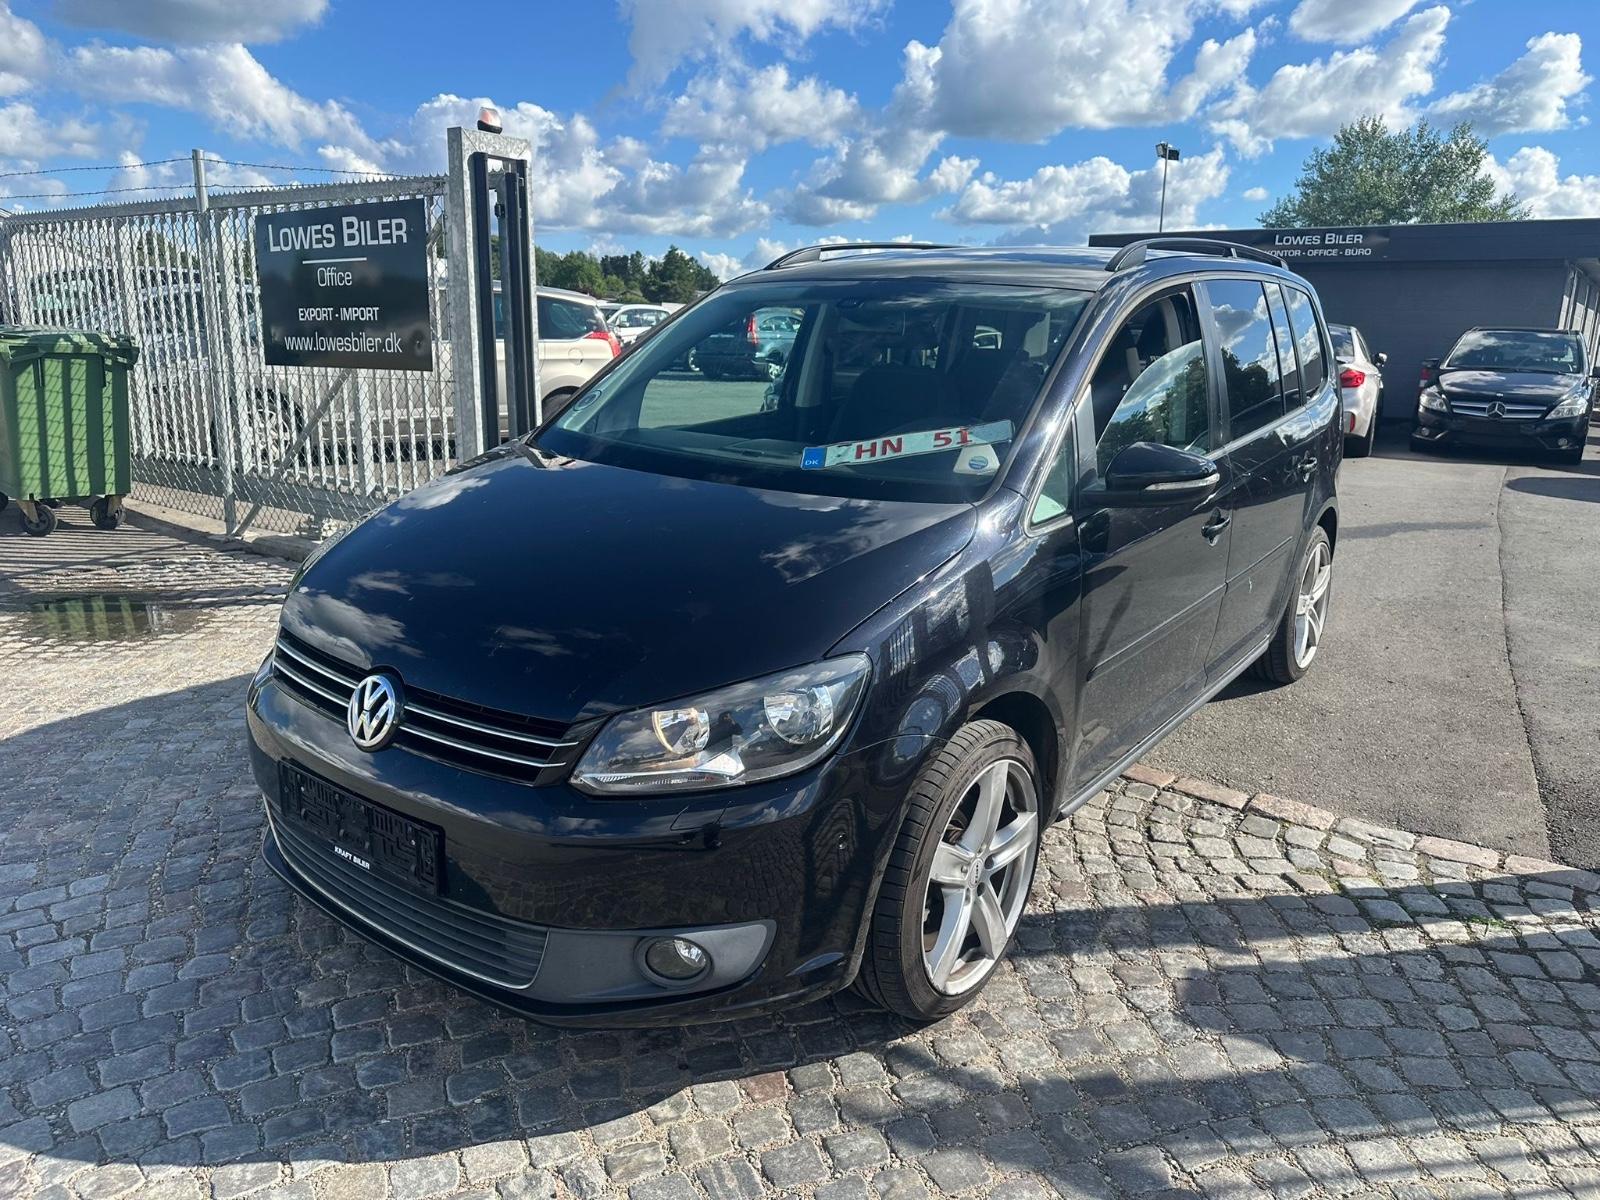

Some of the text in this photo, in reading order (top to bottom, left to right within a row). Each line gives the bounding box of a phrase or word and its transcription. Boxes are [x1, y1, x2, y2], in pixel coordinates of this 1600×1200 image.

[1307, 249, 1338, 257] OFFICE
[317, 266, 353, 287] Office
[298, 308, 334, 321] EXPORT
[340, 307, 379, 321] IMPORT
[284, 332, 403, 353] www.lowesbiler.dk
[855, 437, 903, 460] HN
[804, 458, 819, 466] DK
